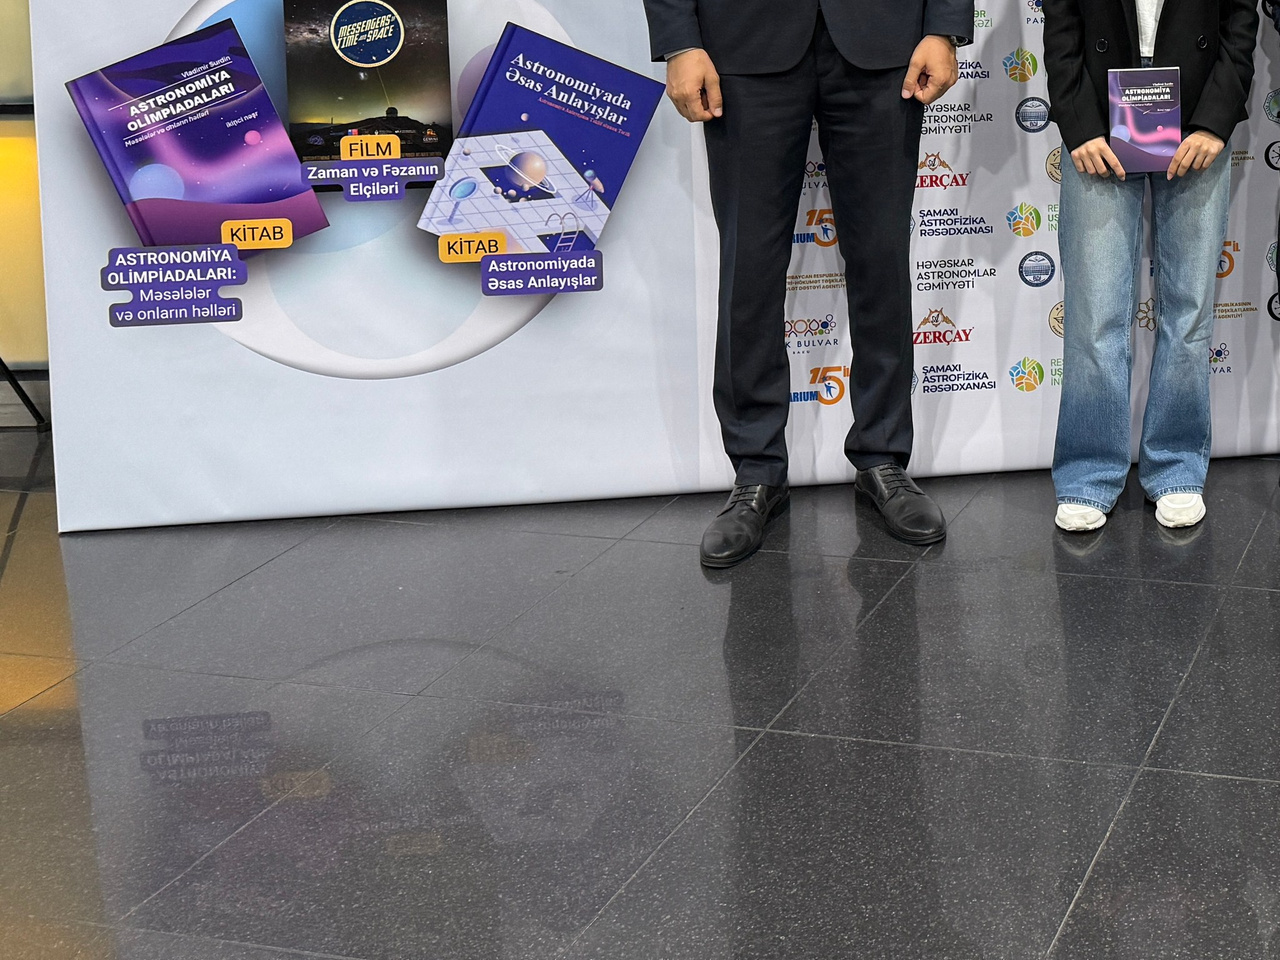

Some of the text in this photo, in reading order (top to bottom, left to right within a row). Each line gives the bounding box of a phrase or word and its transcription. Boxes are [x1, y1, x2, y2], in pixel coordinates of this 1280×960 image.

[338, 14, 391, 38] MESSENGERS
[337, 34, 358, 49] TIME
[366, 25, 394, 43] SPACE
[181, 55, 231, 79] Vladimir Surdin
[510, 52, 632, 110] Astronomiyada
[128, 69, 231, 117] ASTRONOMİYA
[505, 67, 543, 93] Əsas
[544, 81, 628, 127] Anlayışlar
[126, 82, 235, 132] OLİMPİADALARI
[923, 103, 971, 113] ƏVƏSKAR
[921, 113, 993, 124] STRONOMLAR
[921, 122, 971, 135] ƏMİYYƏTİ
[349, 140, 392, 157] FİLM
[307, 164, 439, 180] Zaman və Fəzanın
[350, 182, 399, 198] Elçiləri
[919, 208, 958, 219] ŞAMAXI
[919, 215, 986, 227] ASTROFİZİKA
[230, 224, 284, 242] KİTAB
[919, 225, 993, 237] RƏSƏDXANASI
[447, 237, 499, 255] KİTAB
[115, 248, 232, 266] ASTRONOMİYA
[488, 256, 596, 274] Astronomiyada
[916, 259, 974, 270] HƏVƏSKAR
[107, 267, 237, 285] OLİMPİADALARI:
[488, 274, 597, 292] Əsas Anlayışlar
[916, 268, 996, 281] ASTRONOMLAR
[916, 278, 975, 292] CƏMİYYƏTİ
[139, 286, 212, 302] Məsələlər
[116, 304, 236, 321] və onların həlləri
[797, 339, 839, 348] BULVAR
[912, 328, 973, 345] ZERÇAY
[922, 363, 961, 375] ŞAMAXI
[922, 371, 989, 383] ASTROFİZİKA
[809, 366, 845, 405] 15
[922, 381, 996, 393] RƏSƏDXANASI
